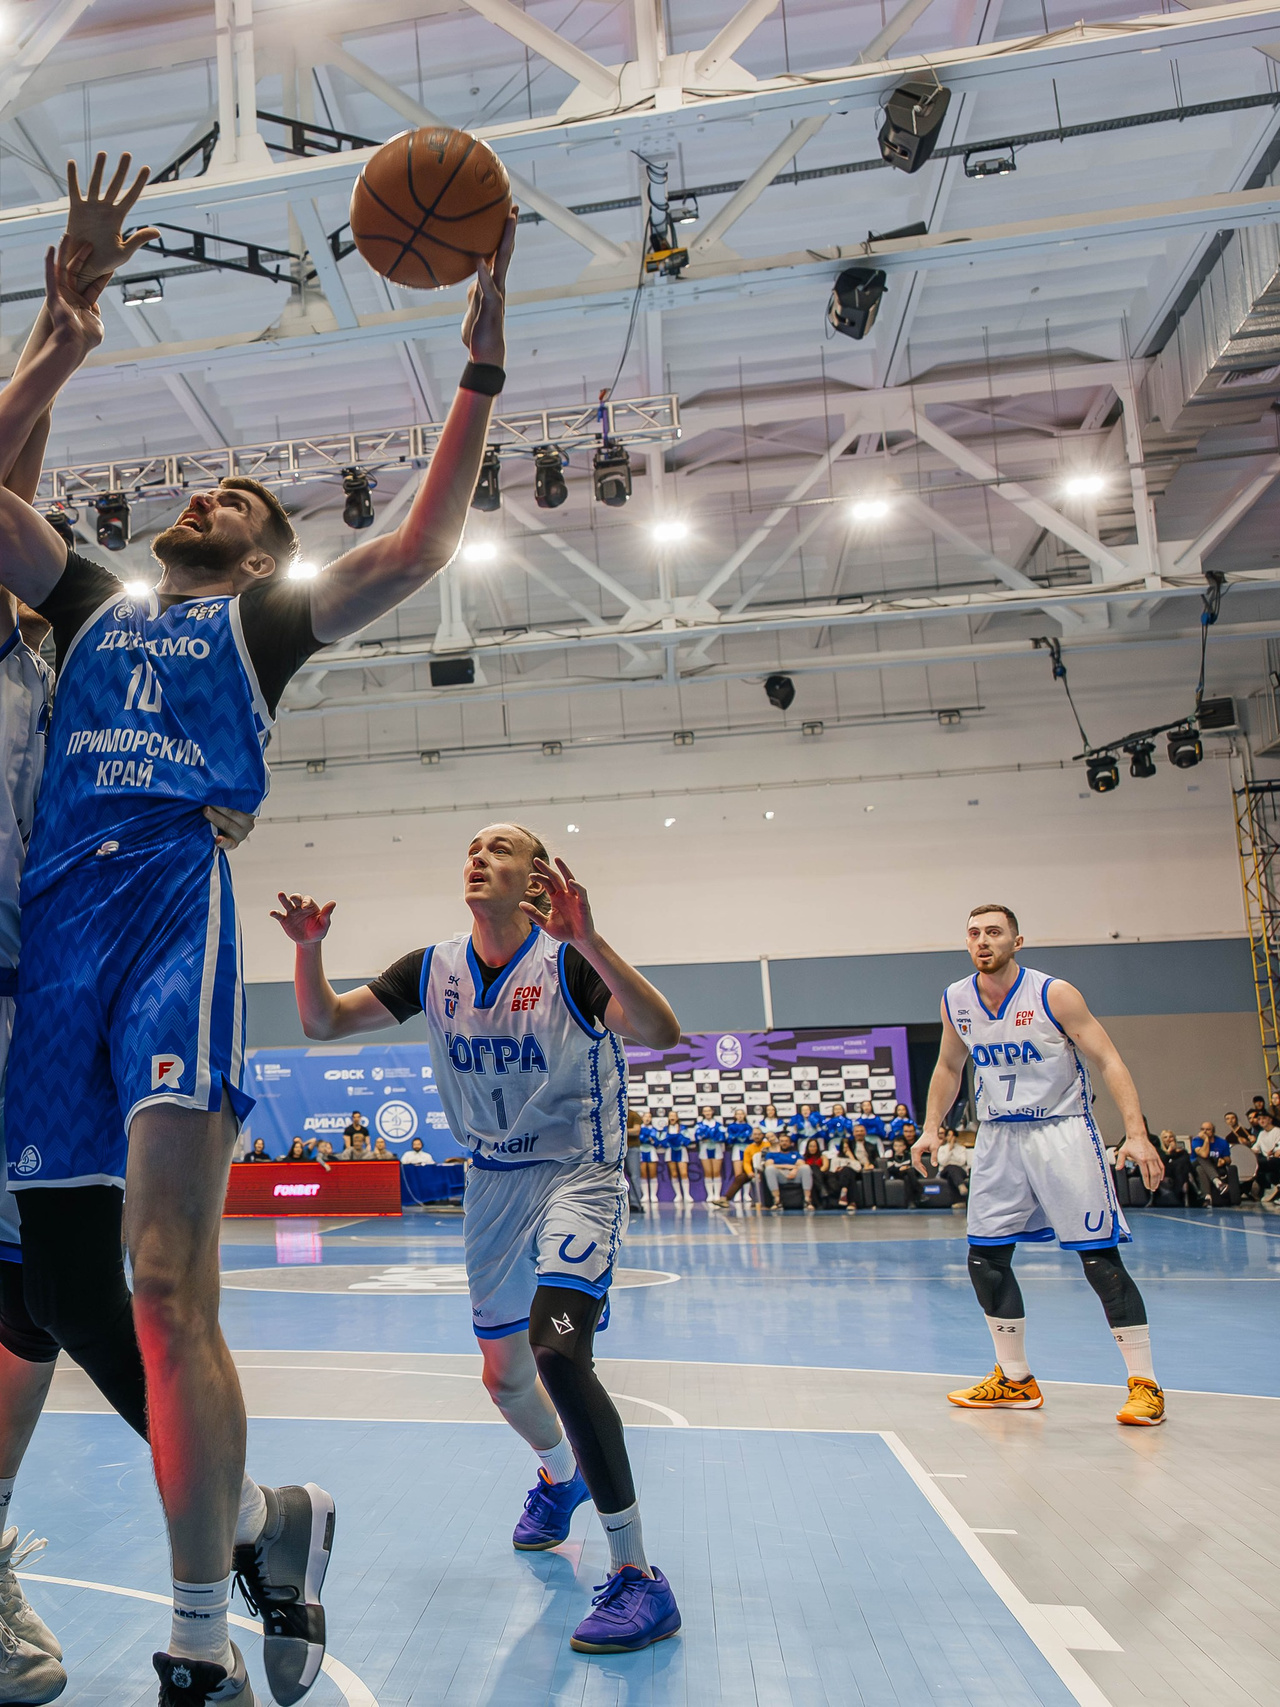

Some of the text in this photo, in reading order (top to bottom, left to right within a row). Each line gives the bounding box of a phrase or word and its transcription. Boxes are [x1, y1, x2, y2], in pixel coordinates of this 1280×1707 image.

[124, 661, 163, 713] 10
[96, 757, 154, 790] КРАЙ
[448, 975, 460, 987] SK
[513, 985, 542, 999] FON
[510, 998, 539, 1012] BET
[1016, 1010, 1035, 1019] FON
[1015, 1018, 1033, 1027] BET
[444, 1032, 549, 1075] ЮГРА
[999, 1074, 1017, 1102] 7
[491, 1087, 508, 1130] 1
[273, 1183, 321, 1198] FONBET
[996, 1325, 1017, 1333] 23
